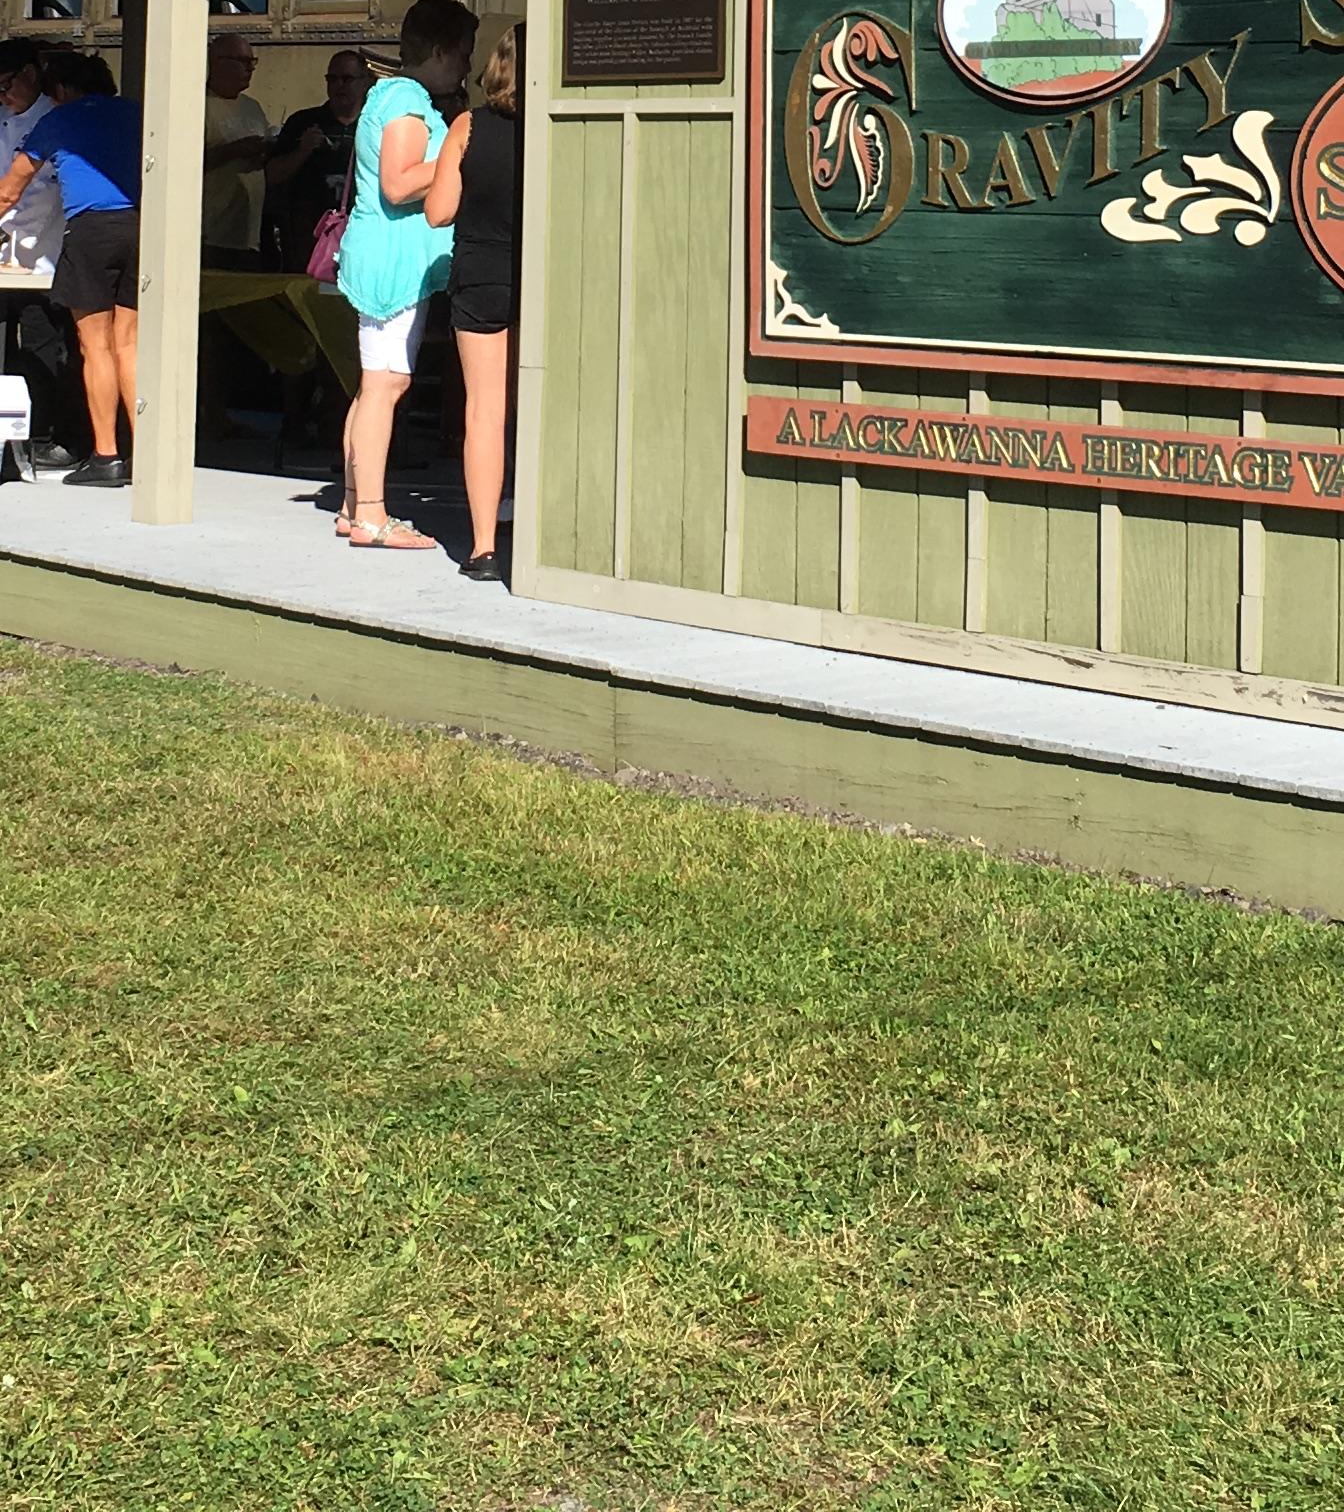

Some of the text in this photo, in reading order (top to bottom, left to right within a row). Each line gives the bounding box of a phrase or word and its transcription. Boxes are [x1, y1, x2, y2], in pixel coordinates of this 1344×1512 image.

[776, 407, 805, 445] A
[809, 410, 1074, 473] LACKAWANNA
[1081, 433, 1293, 492] HERITAGE
